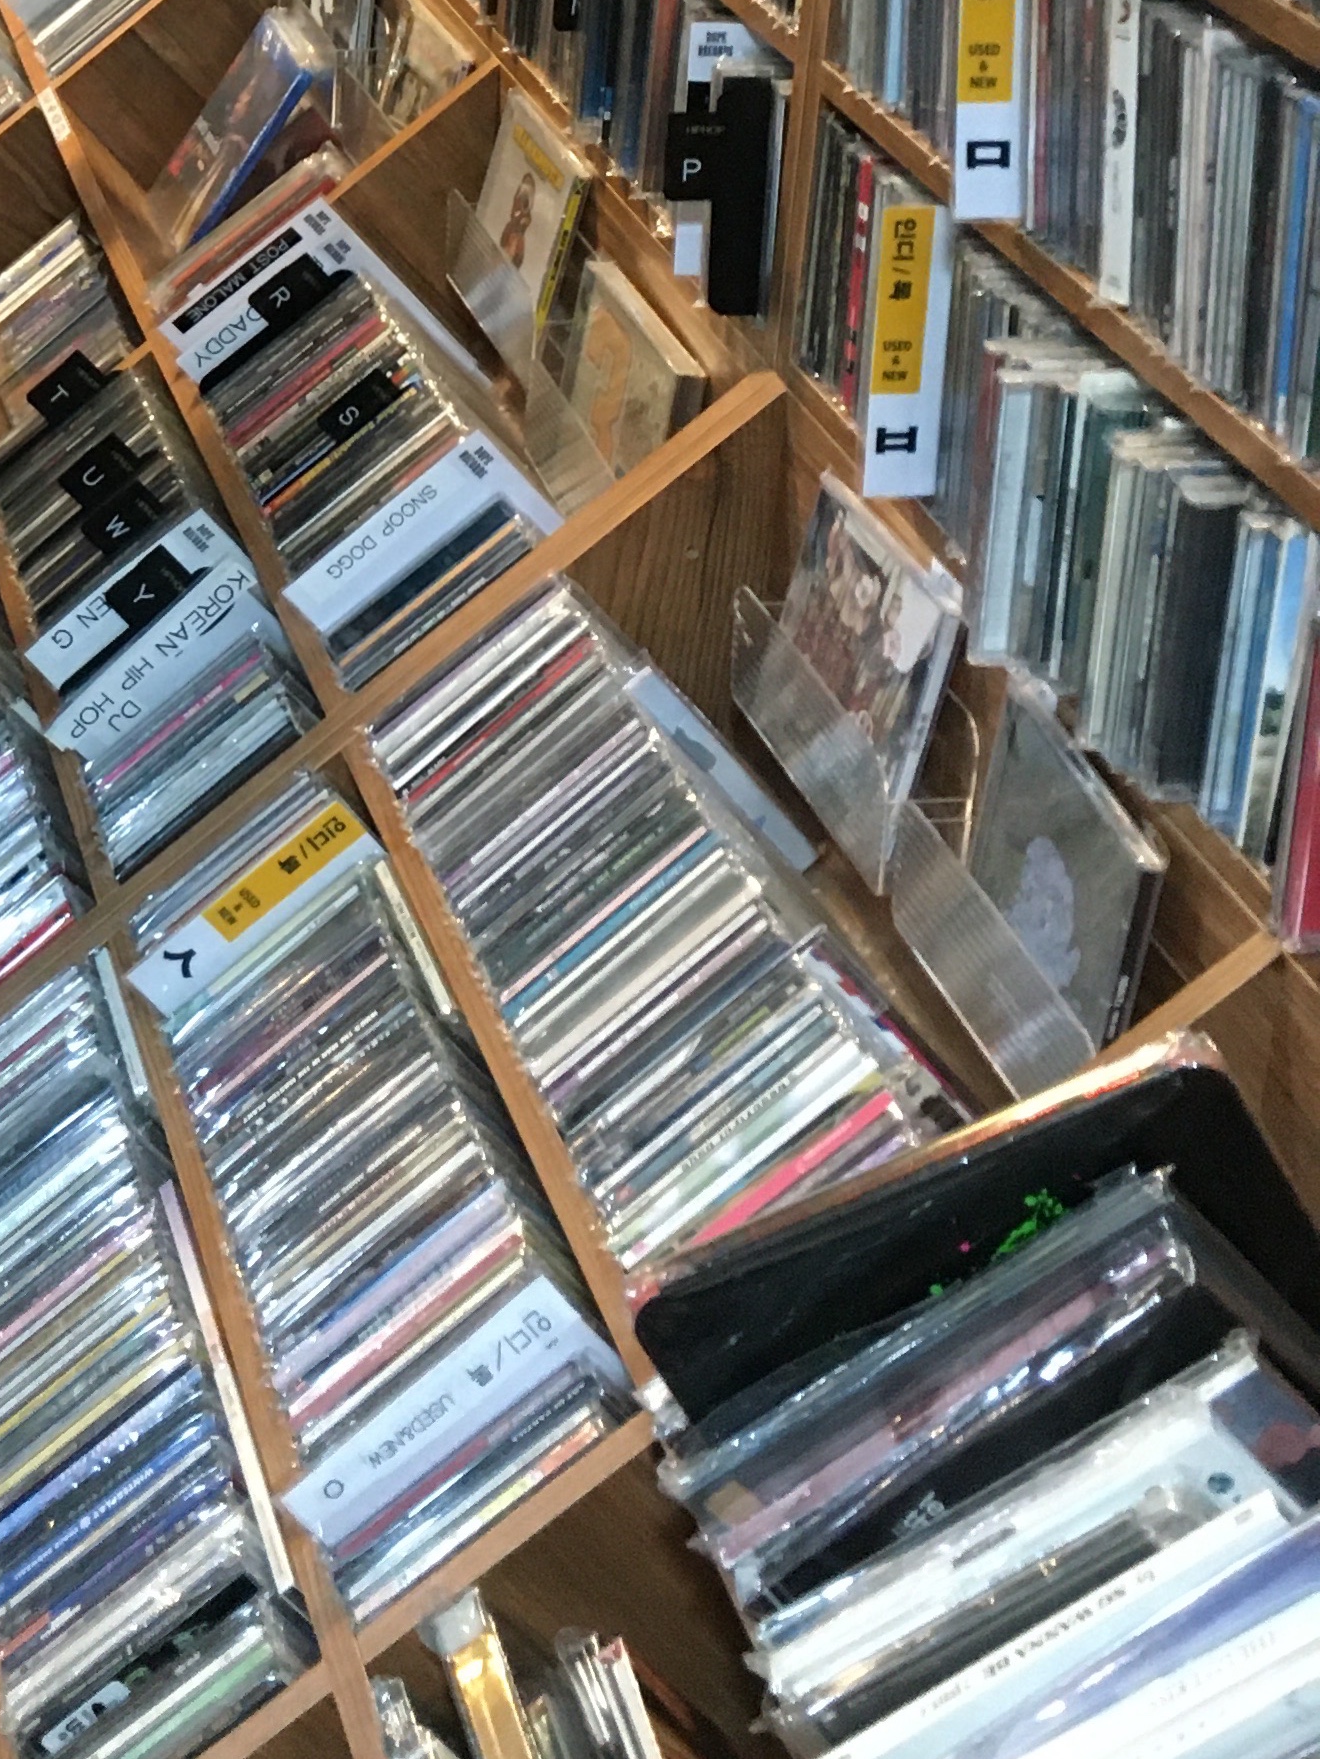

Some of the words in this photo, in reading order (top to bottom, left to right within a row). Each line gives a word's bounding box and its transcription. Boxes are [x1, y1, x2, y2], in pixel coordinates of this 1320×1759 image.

[683, 158, 702, 182] P
[245, 237, 290, 276] POST
[185, 270, 248, 324] MALONE
[267, 286, 290, 307] R
[45, 382, 68, 405] T
[339, 405, 360, 426] S
[83, 464, 106, 487] U
[105, 516, 129, 538] W
[382, 484, 438, 537] SNOOP
[326, 534, 377, 580] DOGG
[133, 583, 156, 603] Y
[154, 568, 248, 657] KOREAN
[51, 629, 74, 651] G
[116, 655, 152, 691] HIP
[65, 691, 113, 739] HOP
[104, 697, 143, 734] DJ
[502, 1309, 552, 1357] 인디
